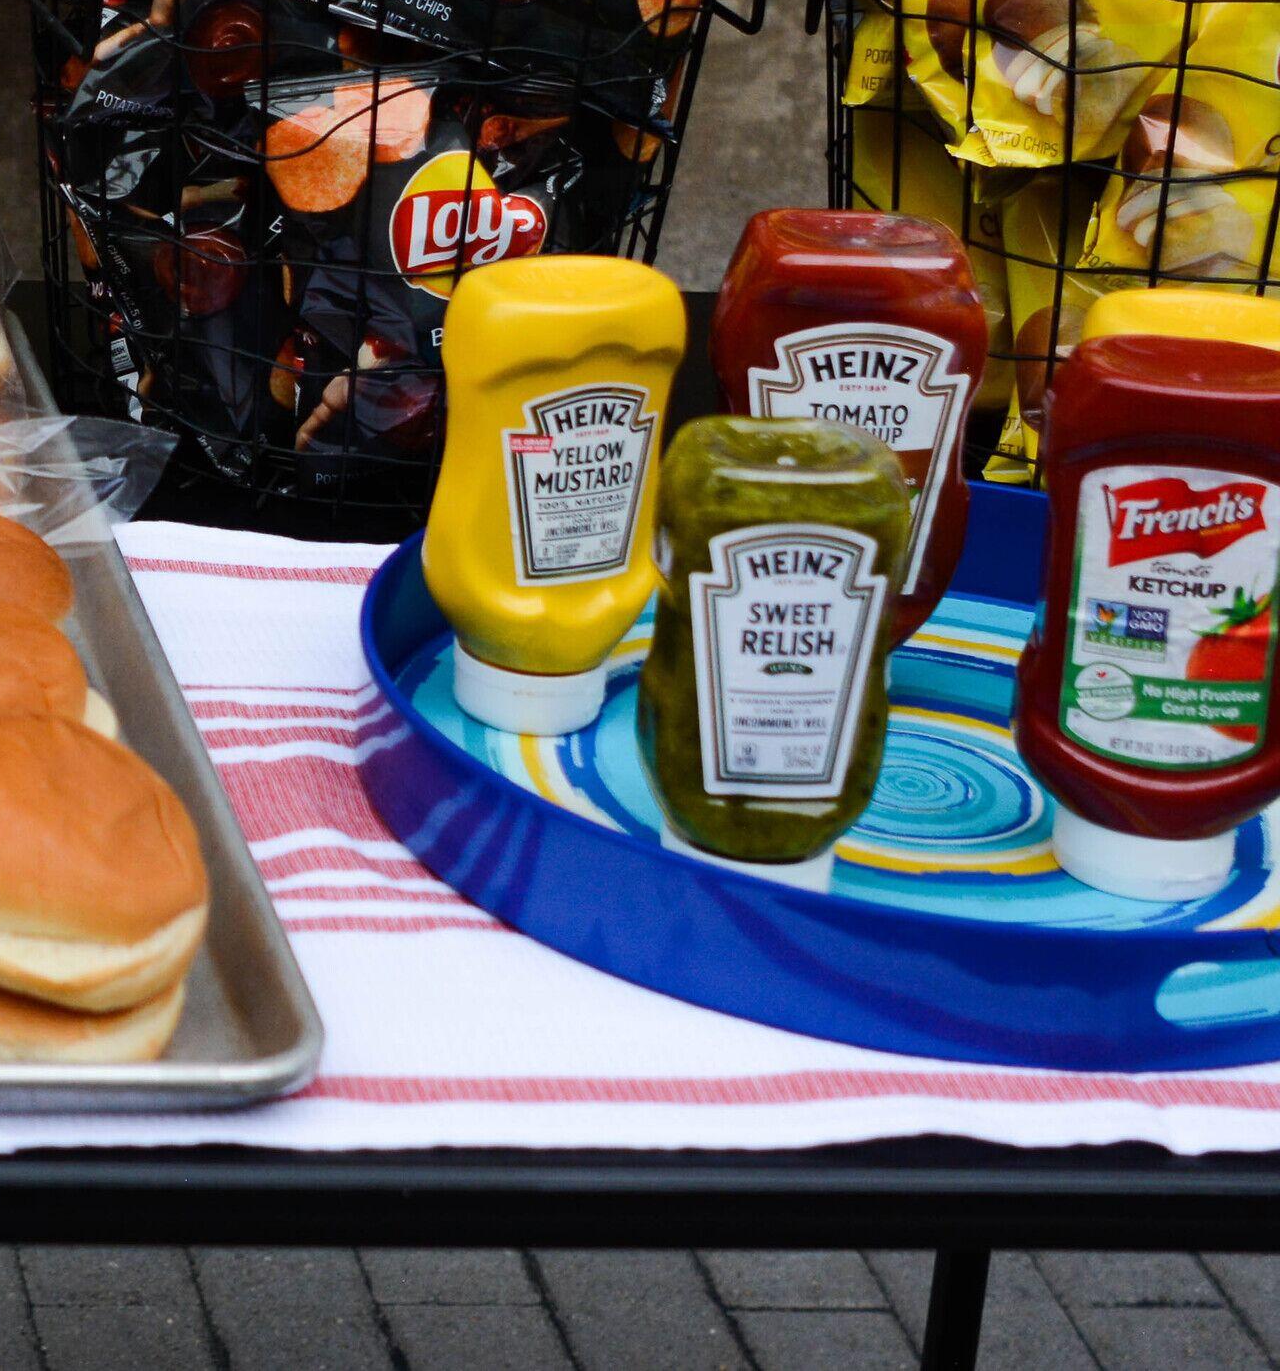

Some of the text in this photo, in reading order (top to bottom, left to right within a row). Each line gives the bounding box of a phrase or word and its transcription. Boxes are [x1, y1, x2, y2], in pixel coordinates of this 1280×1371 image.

[1023, 135, 1059, 158] CHIPS
[809, 350, 919, 385] HEINZ
[553, 402, 632, 433] HEINZ
[809, 402, 910, 427] TOMATO
[552, 439, 626, 467] YELLOW
[534, 461, 633, 494] MUSTARD
[1117, 491, 1256, 540] French's
[747, 549, 844, 579] HEINZ
[1128, 575, 1227, 599] KETCHUP
[748, 602, 833, 626] SWEET
[1132, 609, 1165, 624] NON
[740, 629, 835, 656] RELISH
[1141, 683, 1163, 698] No
[1164, 685, 1199, 702] High
[1200, 688, 1262, 703] Fructose
[1161, 701, 1197, 717] Corn
